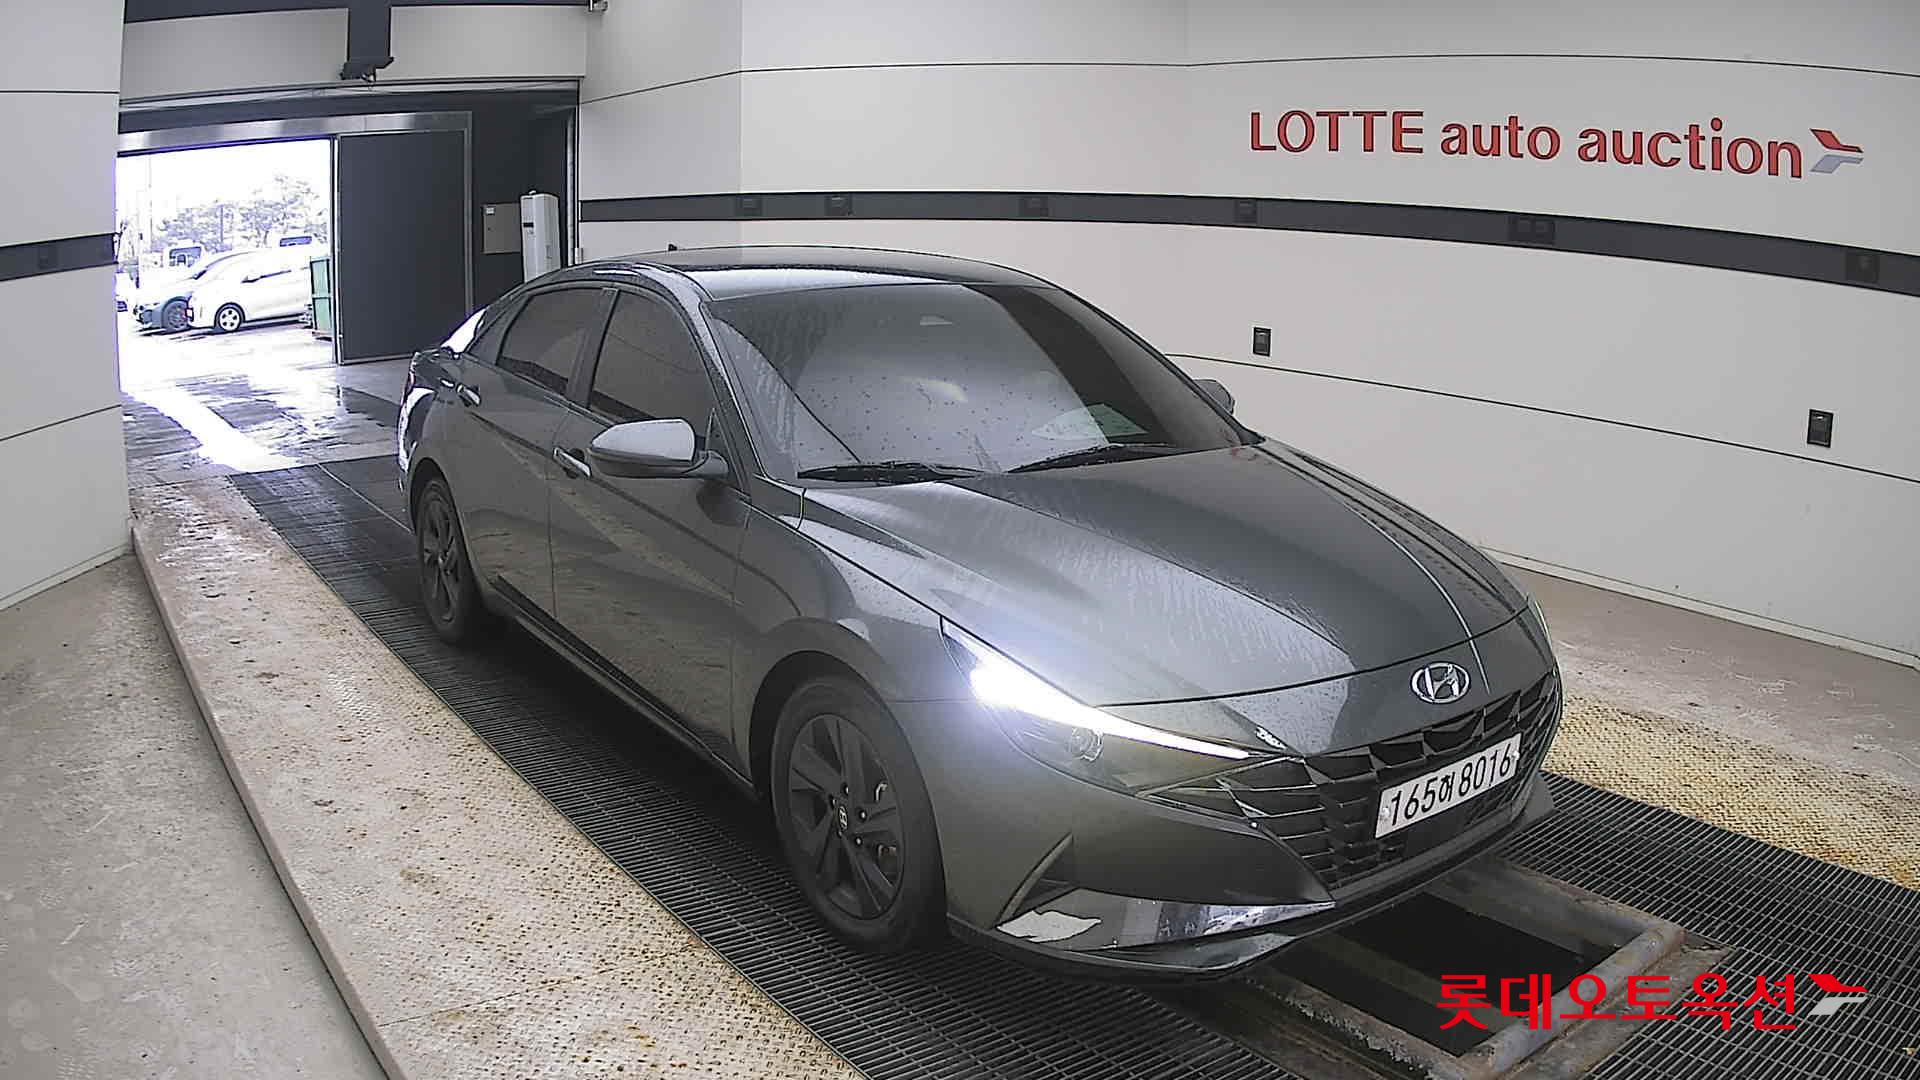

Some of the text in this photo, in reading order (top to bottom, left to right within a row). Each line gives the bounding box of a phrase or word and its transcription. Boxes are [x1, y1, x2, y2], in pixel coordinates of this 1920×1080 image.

[1249, 110, 1803, 179] LOTTE auto auction
